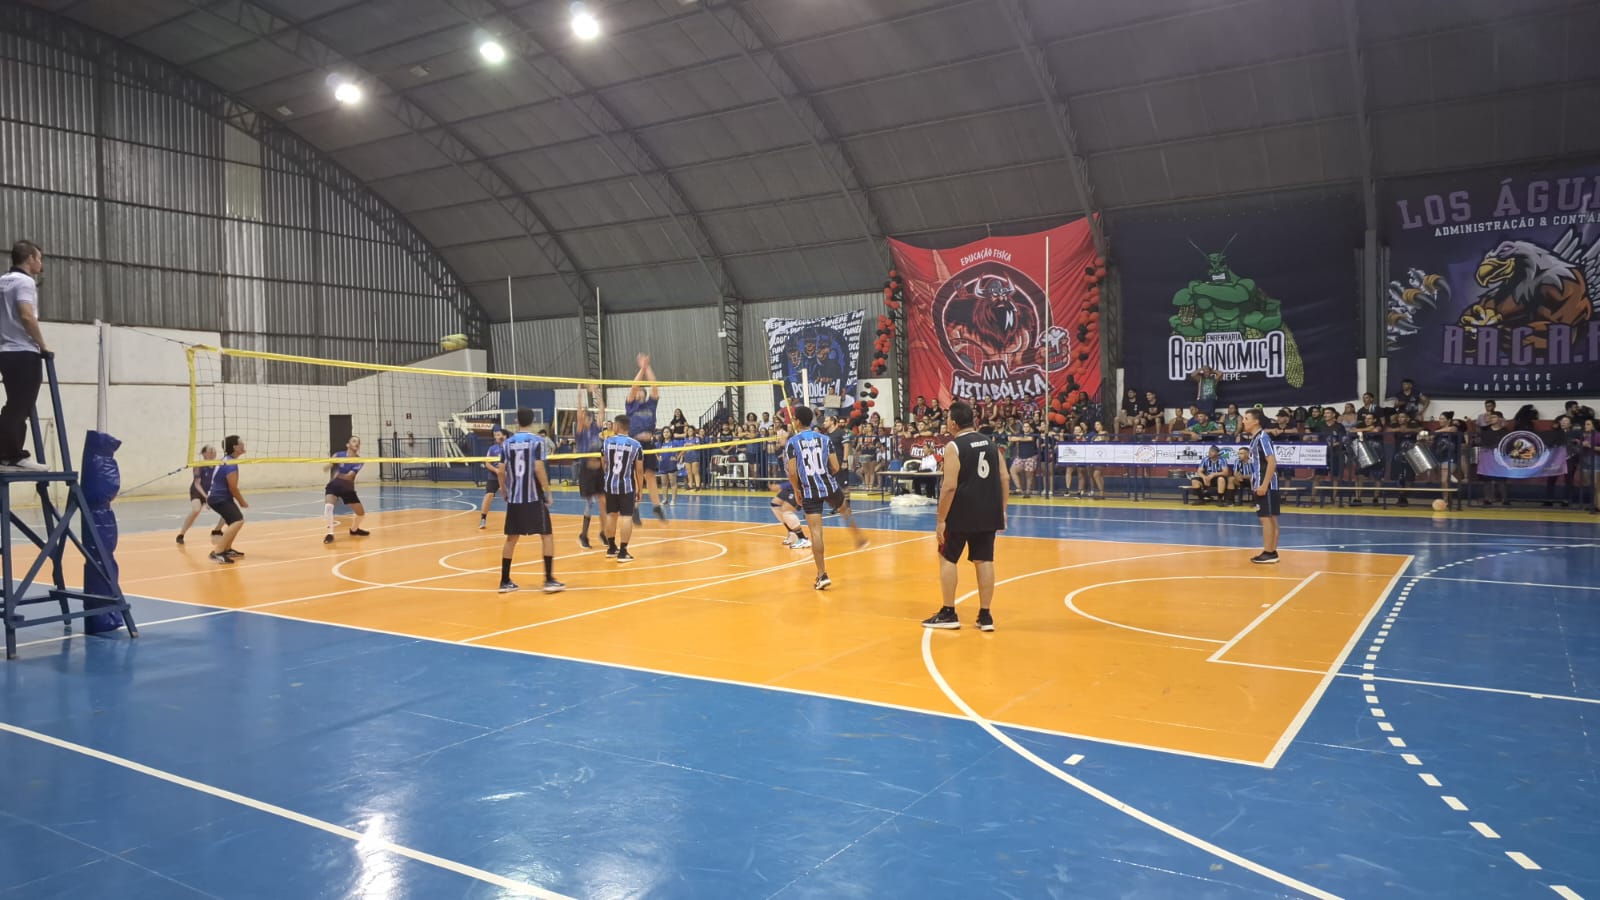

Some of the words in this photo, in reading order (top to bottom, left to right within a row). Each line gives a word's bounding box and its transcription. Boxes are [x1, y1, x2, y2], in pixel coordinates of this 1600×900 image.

[1397, 190, 1472, 230] LOS
[1434, 217, 1535, 237] ADMINISTRAÇÃO
[1539, 216, 1548, 226] &
[1493, 373, 1552, 382] FUNEPE
[514, 449, 526, 477] 6
[802, 448, 826, 476] 30
[977, 451, 990, 479] 6
